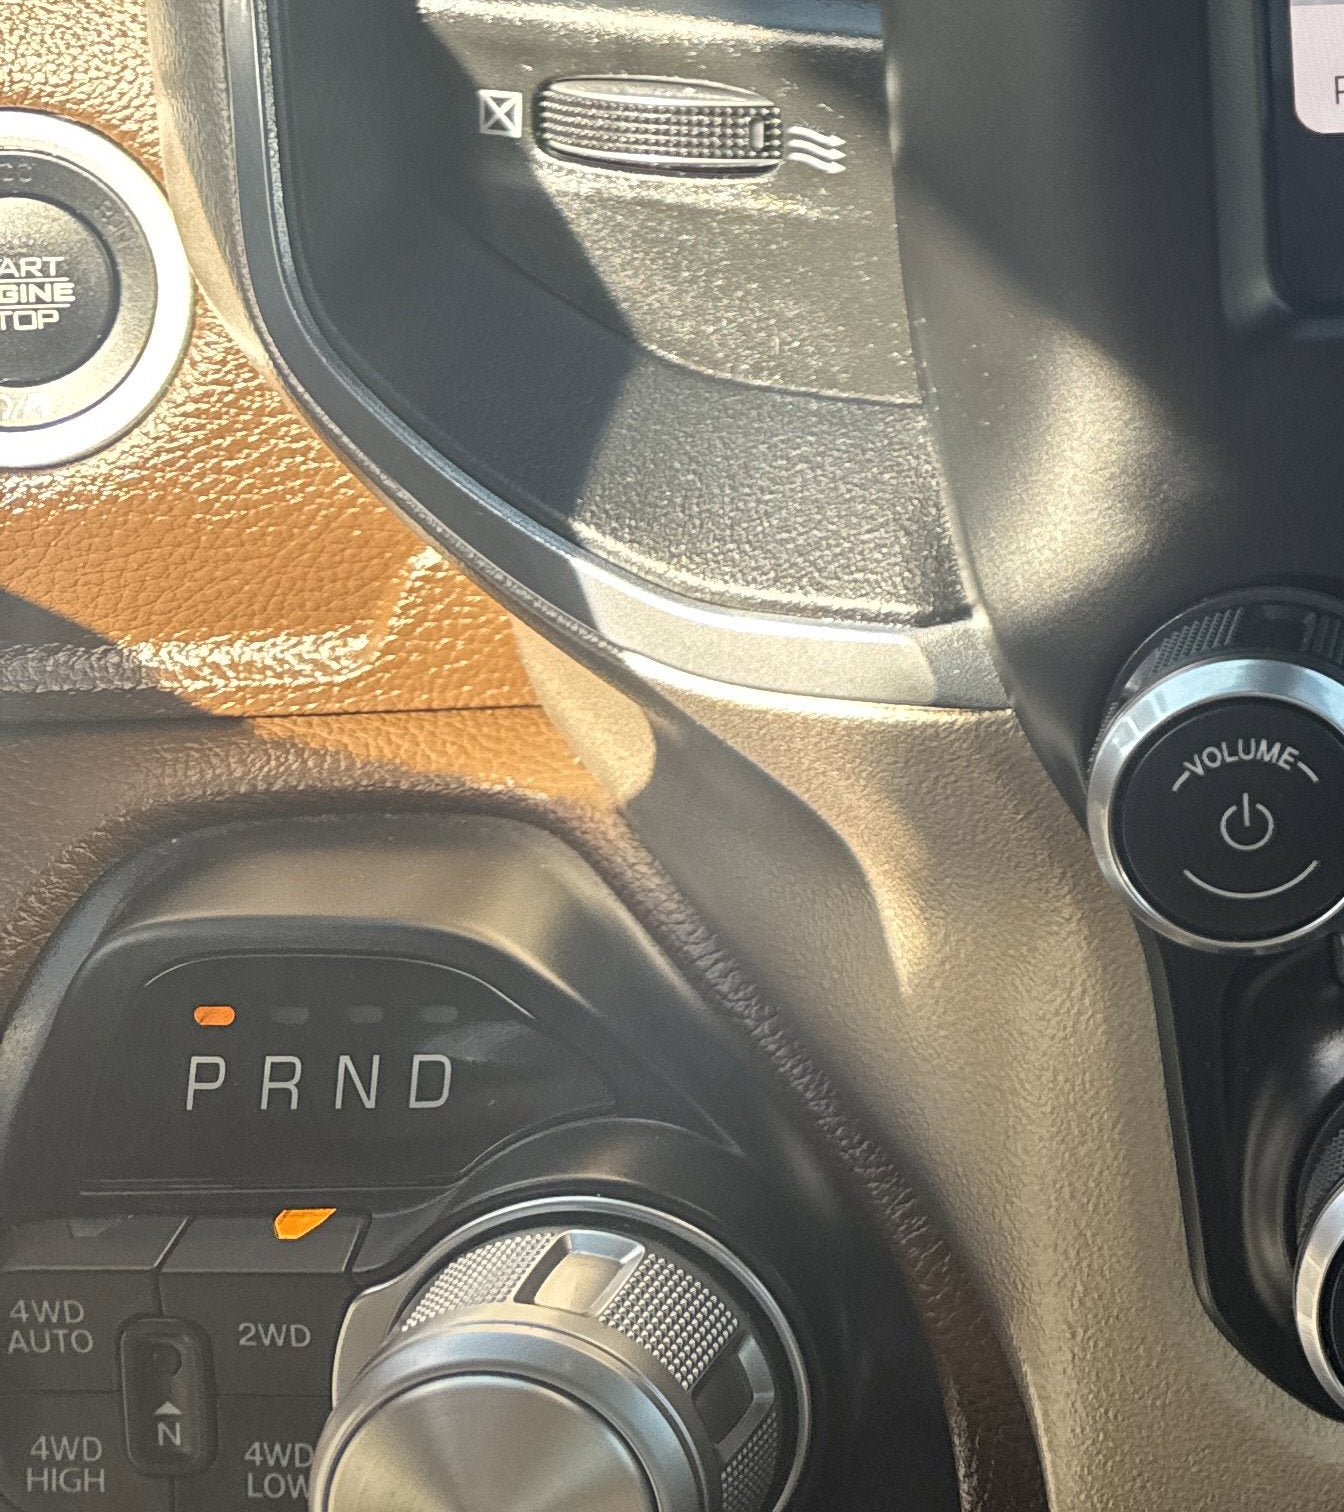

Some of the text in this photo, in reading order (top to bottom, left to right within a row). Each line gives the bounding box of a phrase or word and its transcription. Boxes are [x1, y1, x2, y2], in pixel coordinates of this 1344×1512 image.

[0, 256, 65, 277] ART
[0, 282, 77, 303] GINE
[0, 309, 61, 331] TOP
[1184, 737, 1301, 778] VOLUME
[11, 1299, 84, 1325] 4WD
[7, 1329, 94, 1355] AUTO
[238, 1323, 312, 1349] 2WD
[156, 1421, 182, 1447] N
[29, 1437, 103, 1463] 4WD
[243, 1441, 314, 1468] 4WD
[26, 1467, 106, 1493] HIGH
[247, 1472, 309, 1499] LOW
